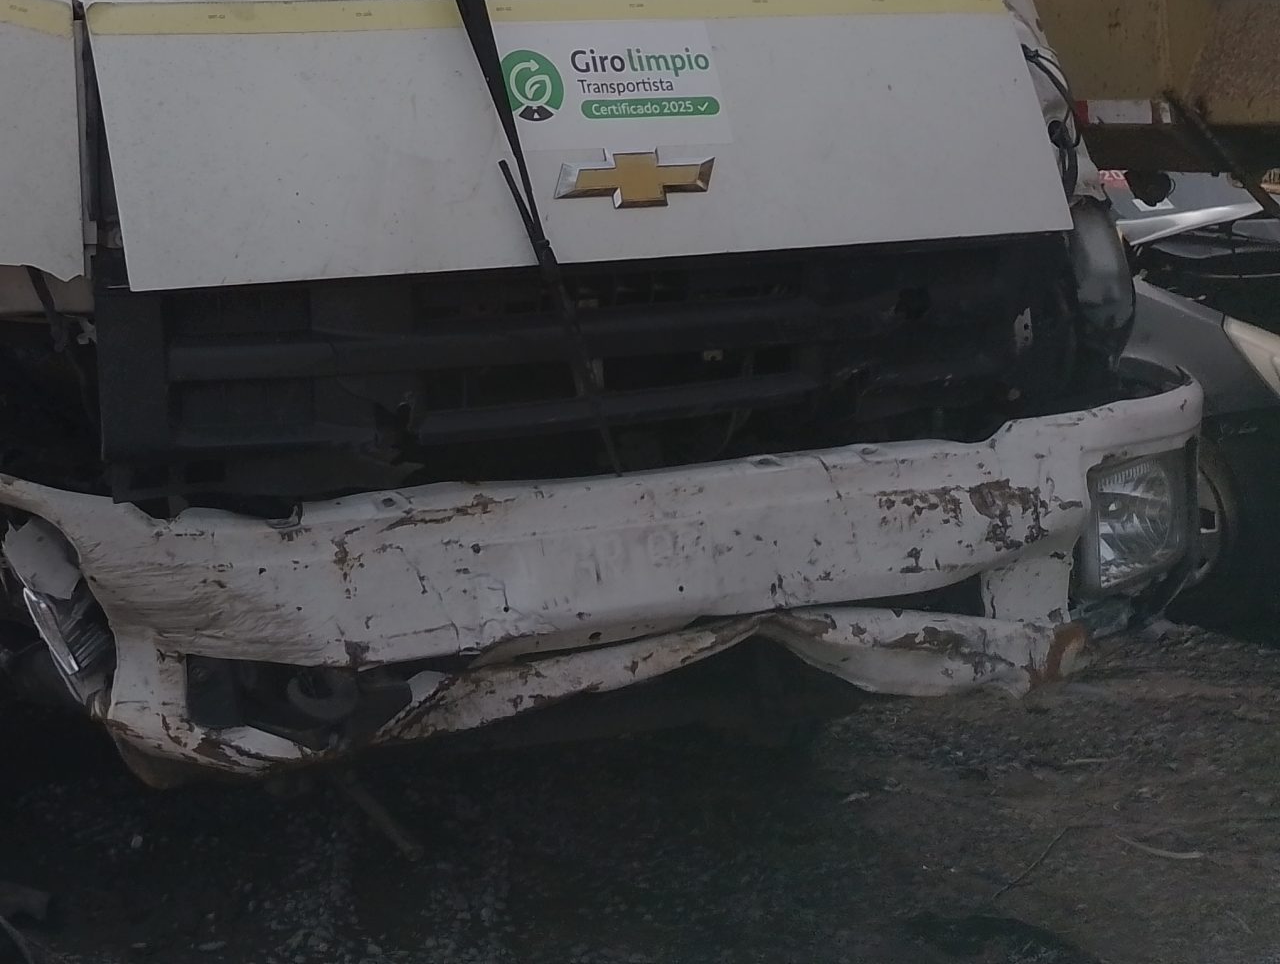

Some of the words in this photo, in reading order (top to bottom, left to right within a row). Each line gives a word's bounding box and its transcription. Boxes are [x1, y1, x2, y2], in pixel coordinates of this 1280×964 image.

[577, 78, 674, 95] Transportista
[591, 101, 660, 116] Certificado
[662, 100, 694, 114] 2025
